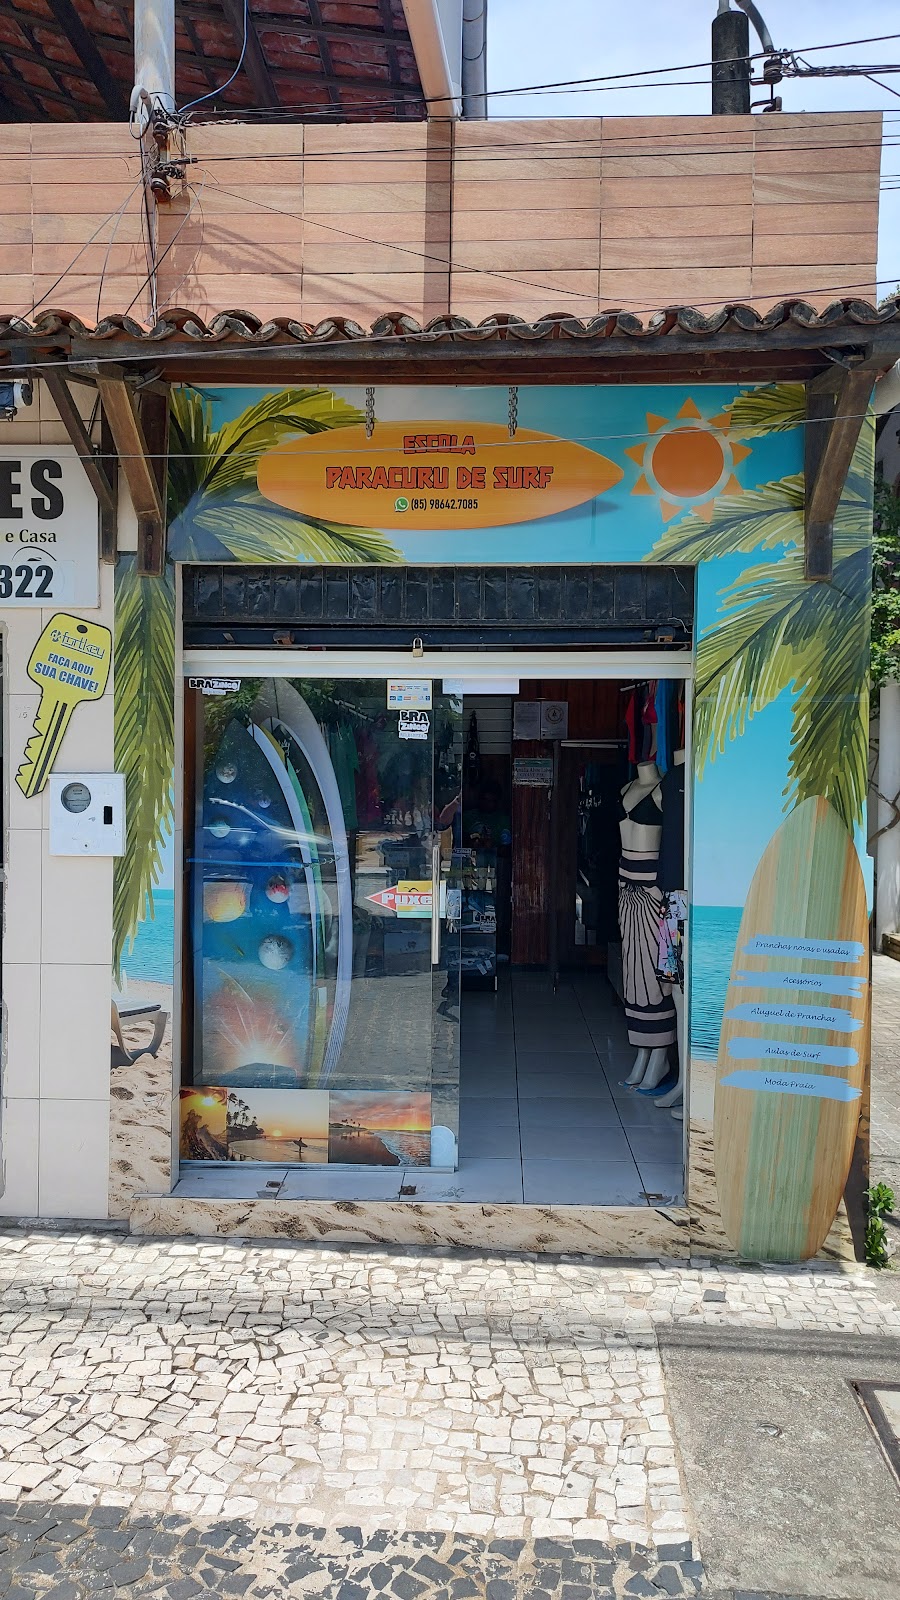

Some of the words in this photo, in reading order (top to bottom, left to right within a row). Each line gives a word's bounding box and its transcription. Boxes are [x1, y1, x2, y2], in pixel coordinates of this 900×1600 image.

[403, 434, 475, 455] ESCOLA
[326, 466, 449, 489] PARACURU
[456, 466, 486, 489] DE
[493, 466, 554, 489] SURF
[411, 498, 427, 511] (85)
[429, 498, 478, 511] 98642.7085
[5, 532, 14, 543] e
[19, 529, 57, 543] Casa
[71, 661, 94, 676] AQUI
[34, 662, 57, 679] SUA
[58, 670, 99, 693] CHAVE!
[381, 893, 433, 905] Puxe
[755, 941, 792, 951] Pranchas
[793, 945, 815, 953] novas
[822, 948, 850, 956] usadas
[751, 1007, 784, 1018] Aluguel
[784, 1010, 797, 1018] de
[797, 1012, 837, 1023] Pranchas
[765, 1047, 790, 1056] Aulas
[790, 1049, 802, 1057] de
[802, 1051, 822, 1060] Surf
[764, 1077, 790, 1088] Moda
[790, 1080, 817, 1090] Praia
